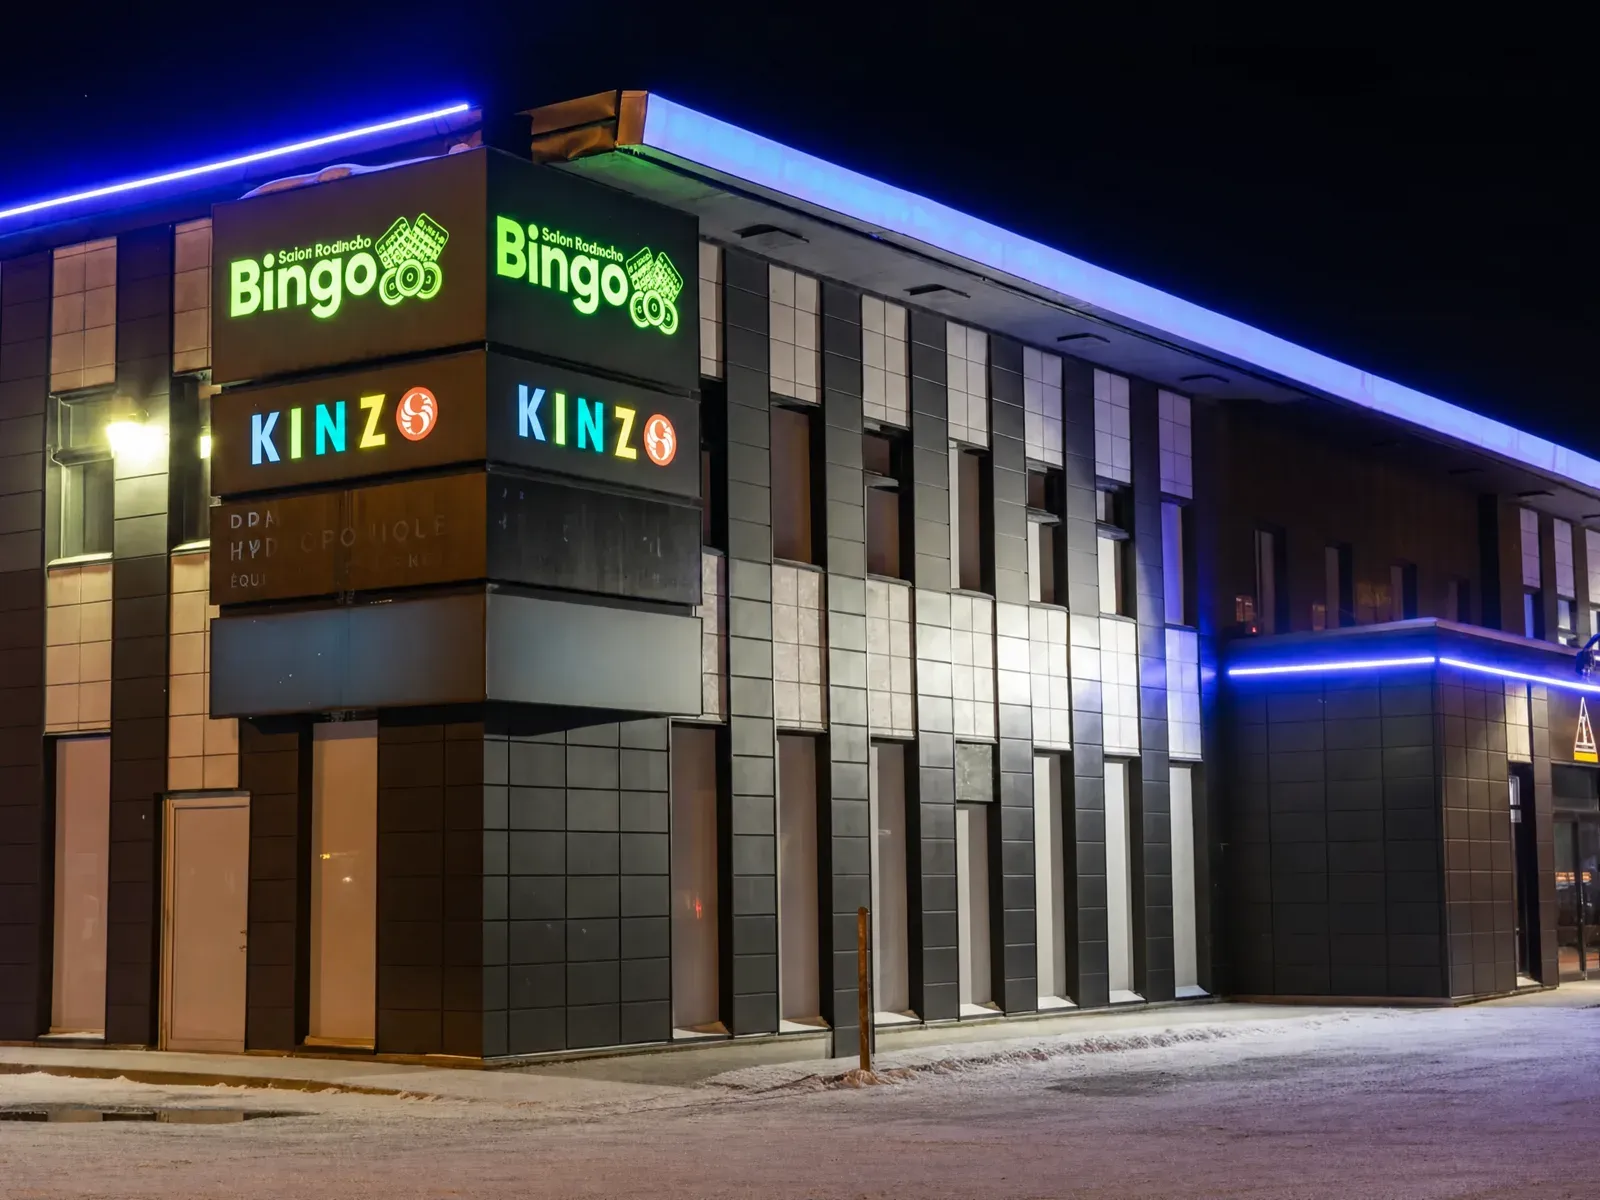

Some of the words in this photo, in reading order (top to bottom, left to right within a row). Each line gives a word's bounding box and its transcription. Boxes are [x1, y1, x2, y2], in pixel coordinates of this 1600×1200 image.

[496, 215, 629, 315] Bingo
[541, 227, 573, 248] Salon
[230, 252, 378, 319] Bingo
